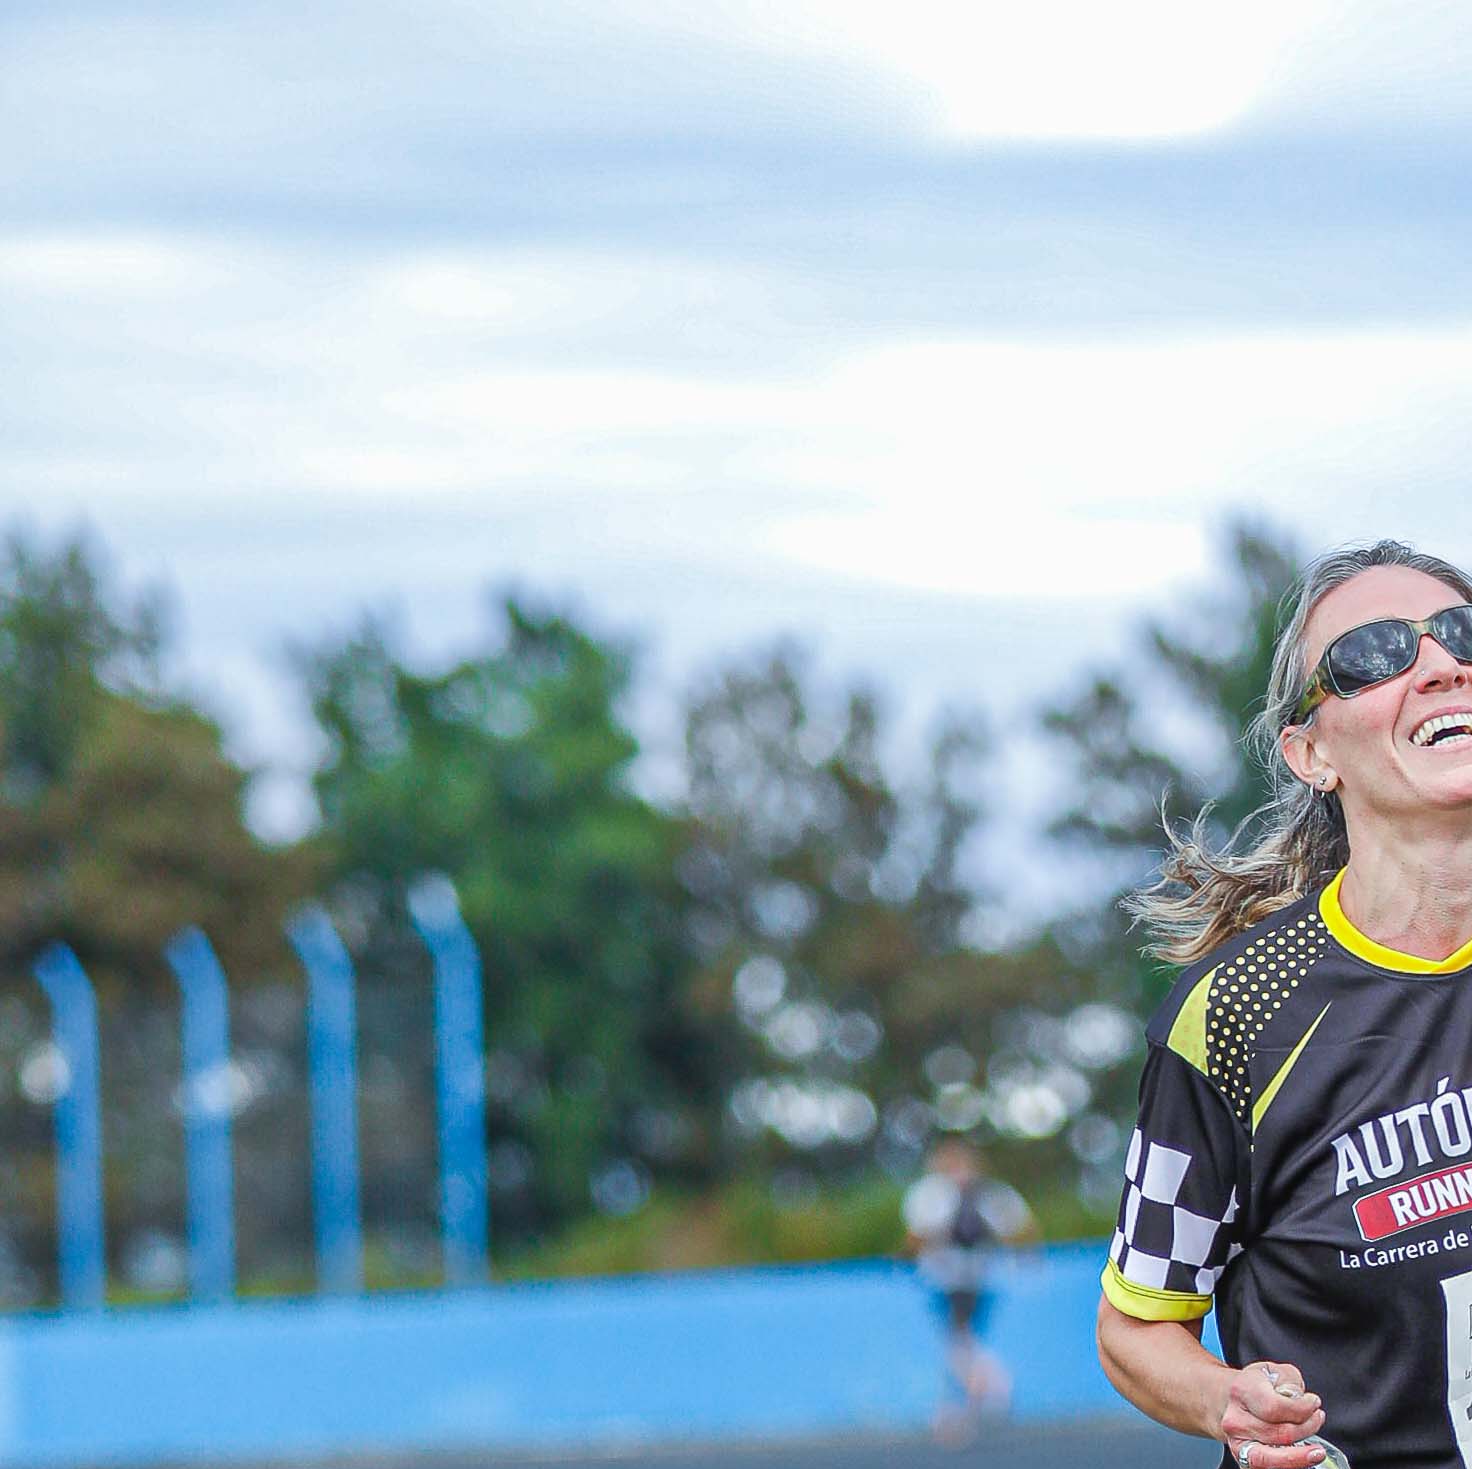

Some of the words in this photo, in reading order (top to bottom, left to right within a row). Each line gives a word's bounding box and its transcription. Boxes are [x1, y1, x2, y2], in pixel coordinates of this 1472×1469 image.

[1340, 1250, 1361, 1269] La
[1363, 1240, 1439, 1268] Carrera
[1442, 1230, 1470, 1252] de
